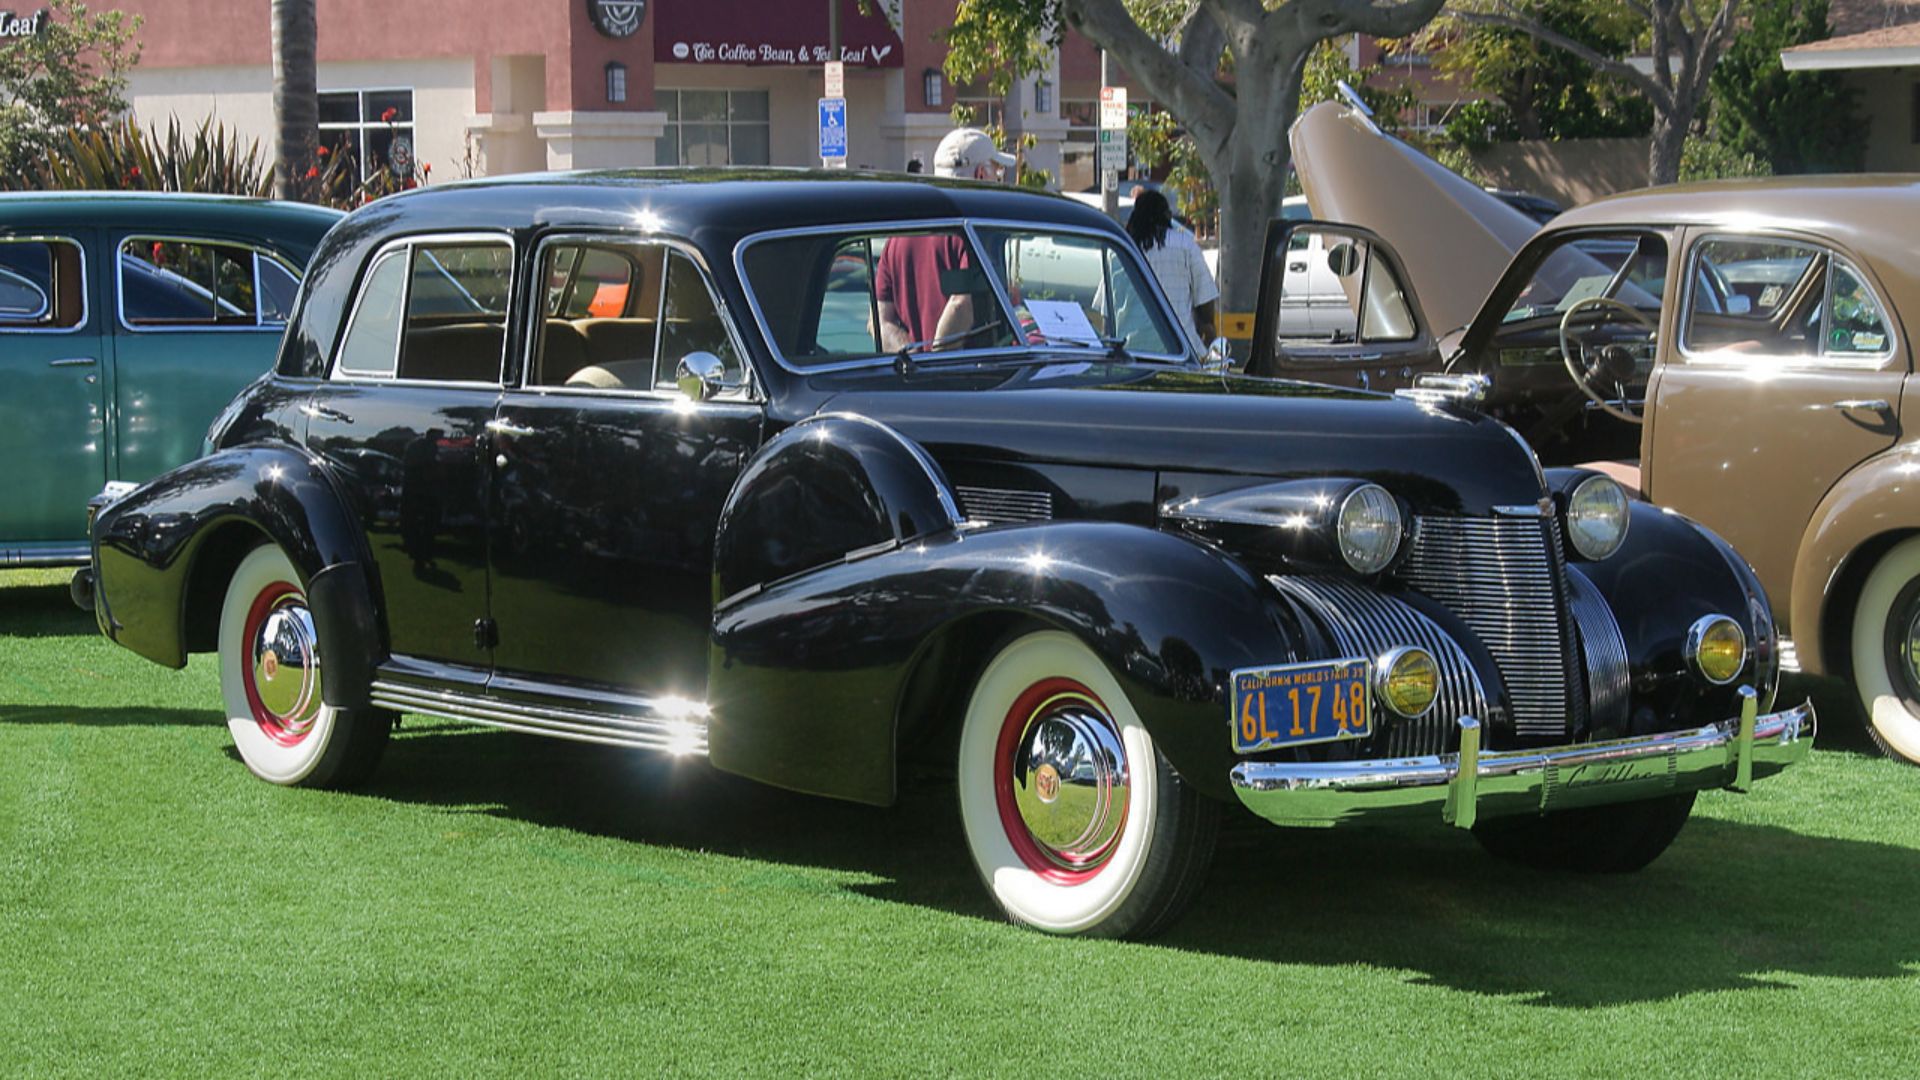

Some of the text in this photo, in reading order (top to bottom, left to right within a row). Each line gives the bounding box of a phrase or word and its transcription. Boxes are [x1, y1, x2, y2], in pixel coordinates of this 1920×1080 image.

[692, 42, 715, 62] The
[719, 42, 757, 61] Coffee
[759, 44, 796, 64] Bean
[798, 45, 809, 61] &
[840, 46, 868, 62] Leaf
[1242, 674, 1291, 690] CALIFORNIA
[1242, 681, 1365, 742] 6L 17 48
[1567, 763, 1655, 787] Cadillac
